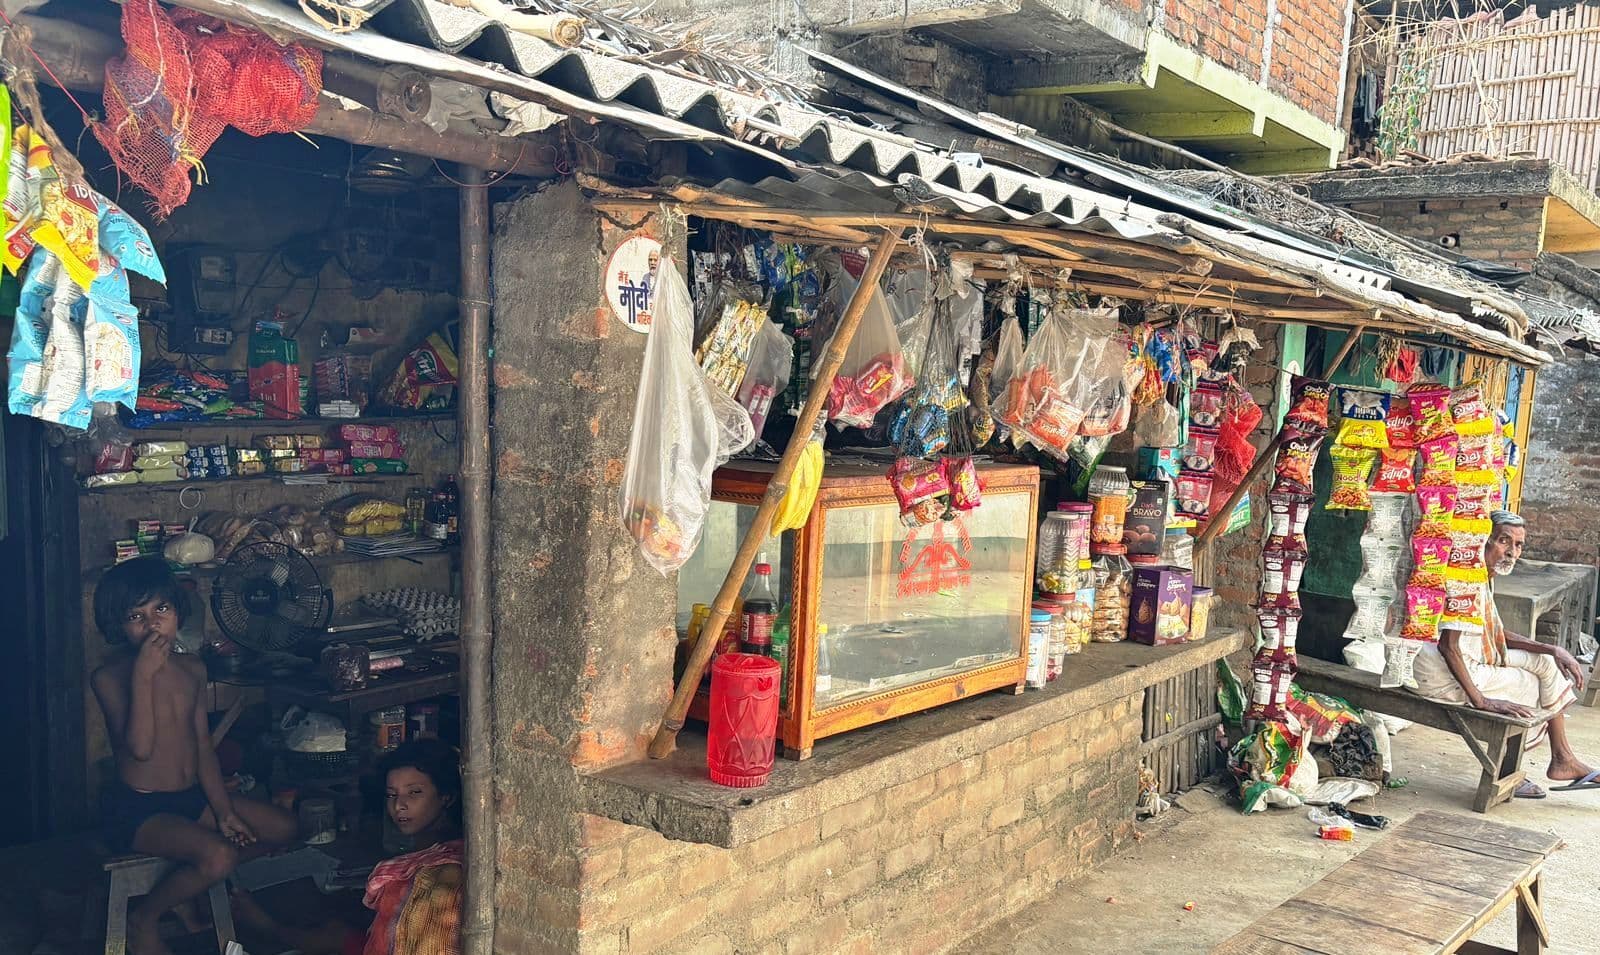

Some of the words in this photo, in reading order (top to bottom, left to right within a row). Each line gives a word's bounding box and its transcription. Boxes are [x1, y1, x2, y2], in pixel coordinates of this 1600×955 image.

[618, 279, 650, 324] मोदी
[1387, 414, 1415, 429] Chips
[1380, 467, 1412, 481] Chips
[1132, 507, 1162, 517] BRAVO
